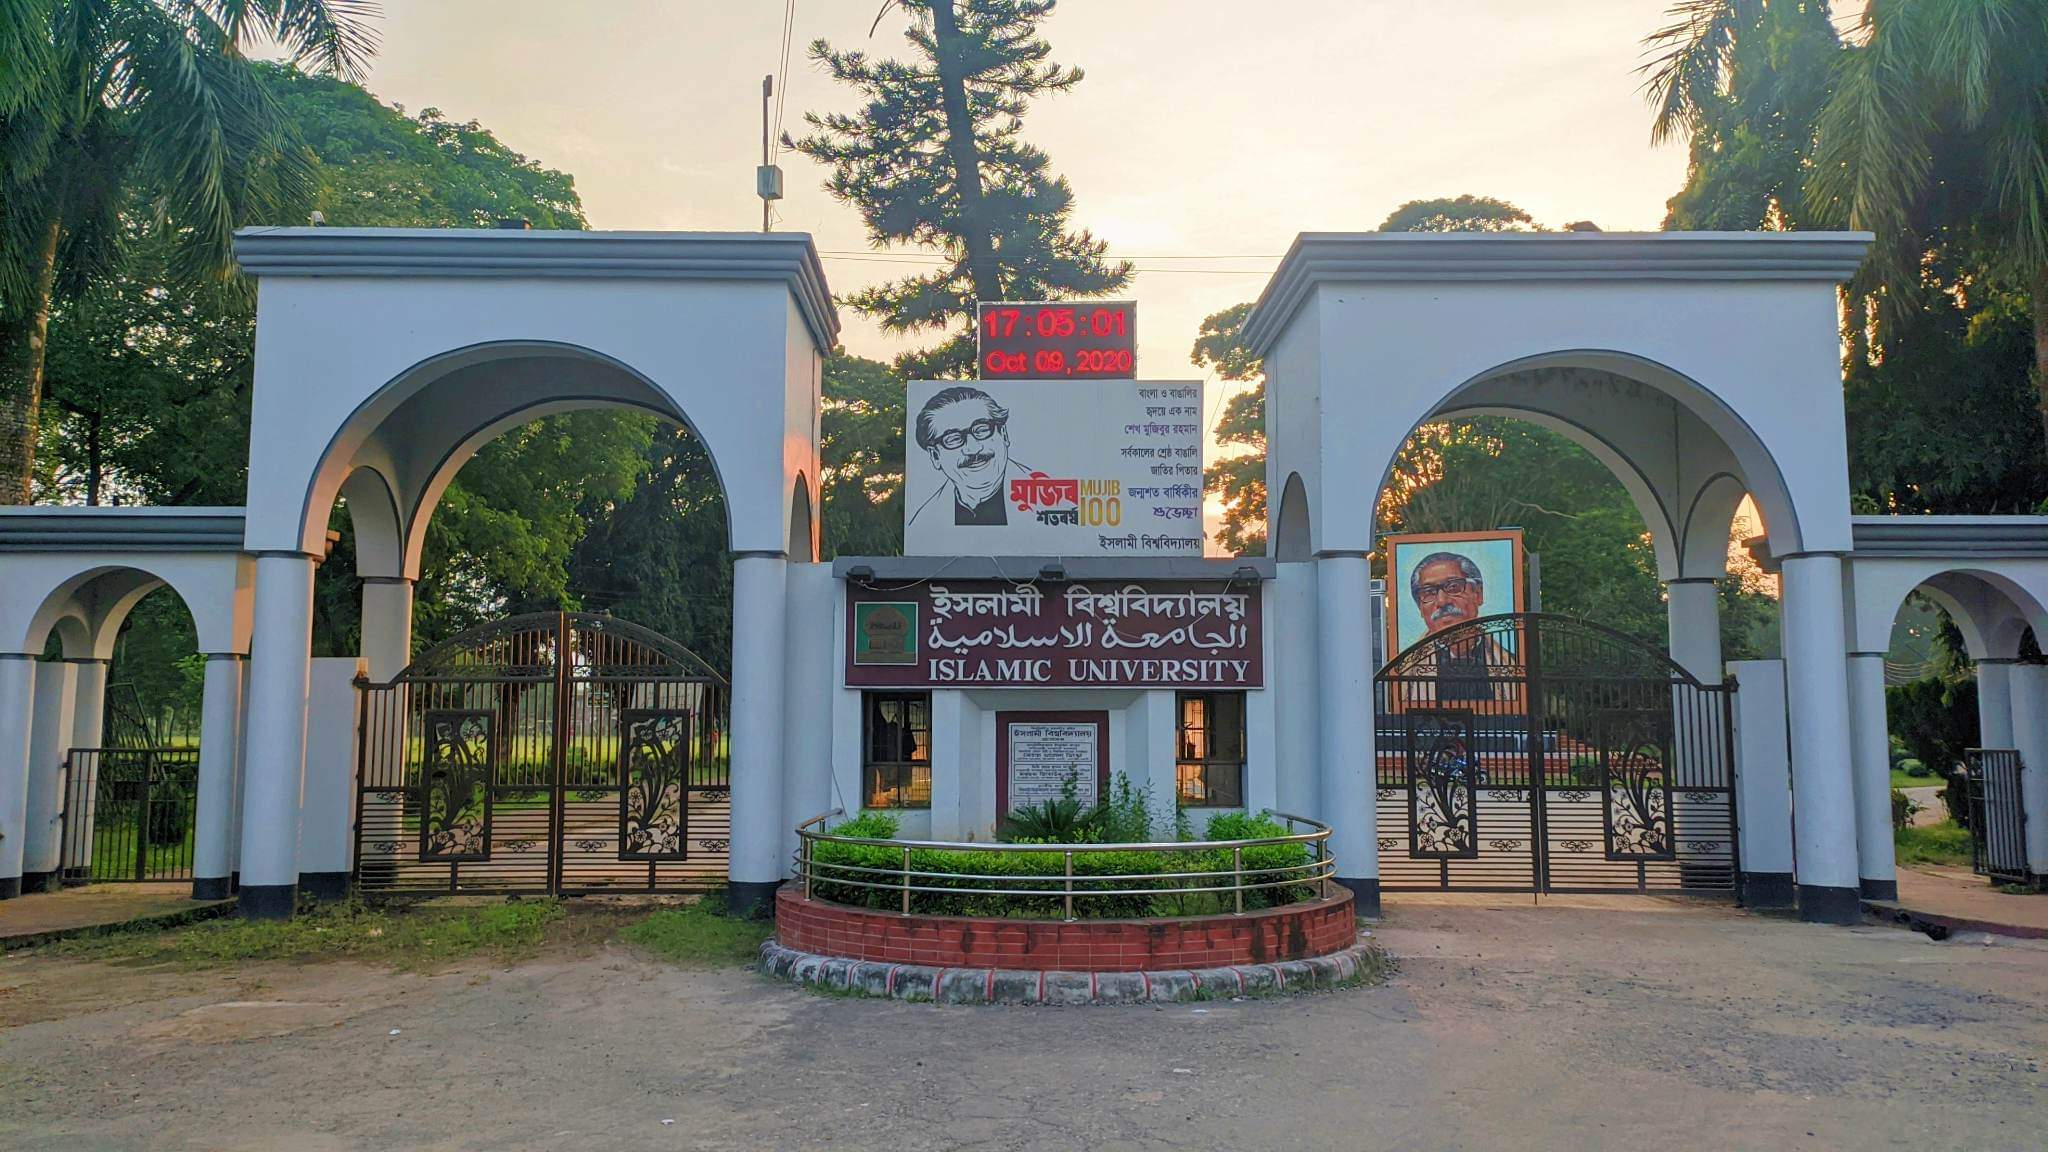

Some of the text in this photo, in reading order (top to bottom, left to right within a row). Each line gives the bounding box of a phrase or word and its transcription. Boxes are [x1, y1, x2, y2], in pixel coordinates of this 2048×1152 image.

[986, 351, 1027, 372] Oct
[1138, 388, 1158, 399] বাংলা
[1161, 390, 1167, 398] ও
[1168, 406, 1182, 416] এক
[1184, 406, 1198, 416] নাম
[1124, 421, 1198, 437] শেখ মুজিবুর রহমান
[1120, 444, 1155, 458] সর্বকালের
[1150, 463, 1198, 476] জাতির পিতার
[1080, 479, 1120, 496] MUJIB
[1162, 483, 1198, 498] বার্ষিকীর
[1036, 506, 1079, 526] শতবর্ষ
[1080, 497, 1121, 527] 100
[1098, 533, 1200, 550] ইসলামী বিশ্ববিদ্যালয়
[929, 583, 1249, 620] ইসলামী বিশ্ববিদ্যালয়
[928, 617, 1247, 655] الجامعة الاسلامية
[928, 658, 1250, 682] ISLAMIC UNIVERSITY
